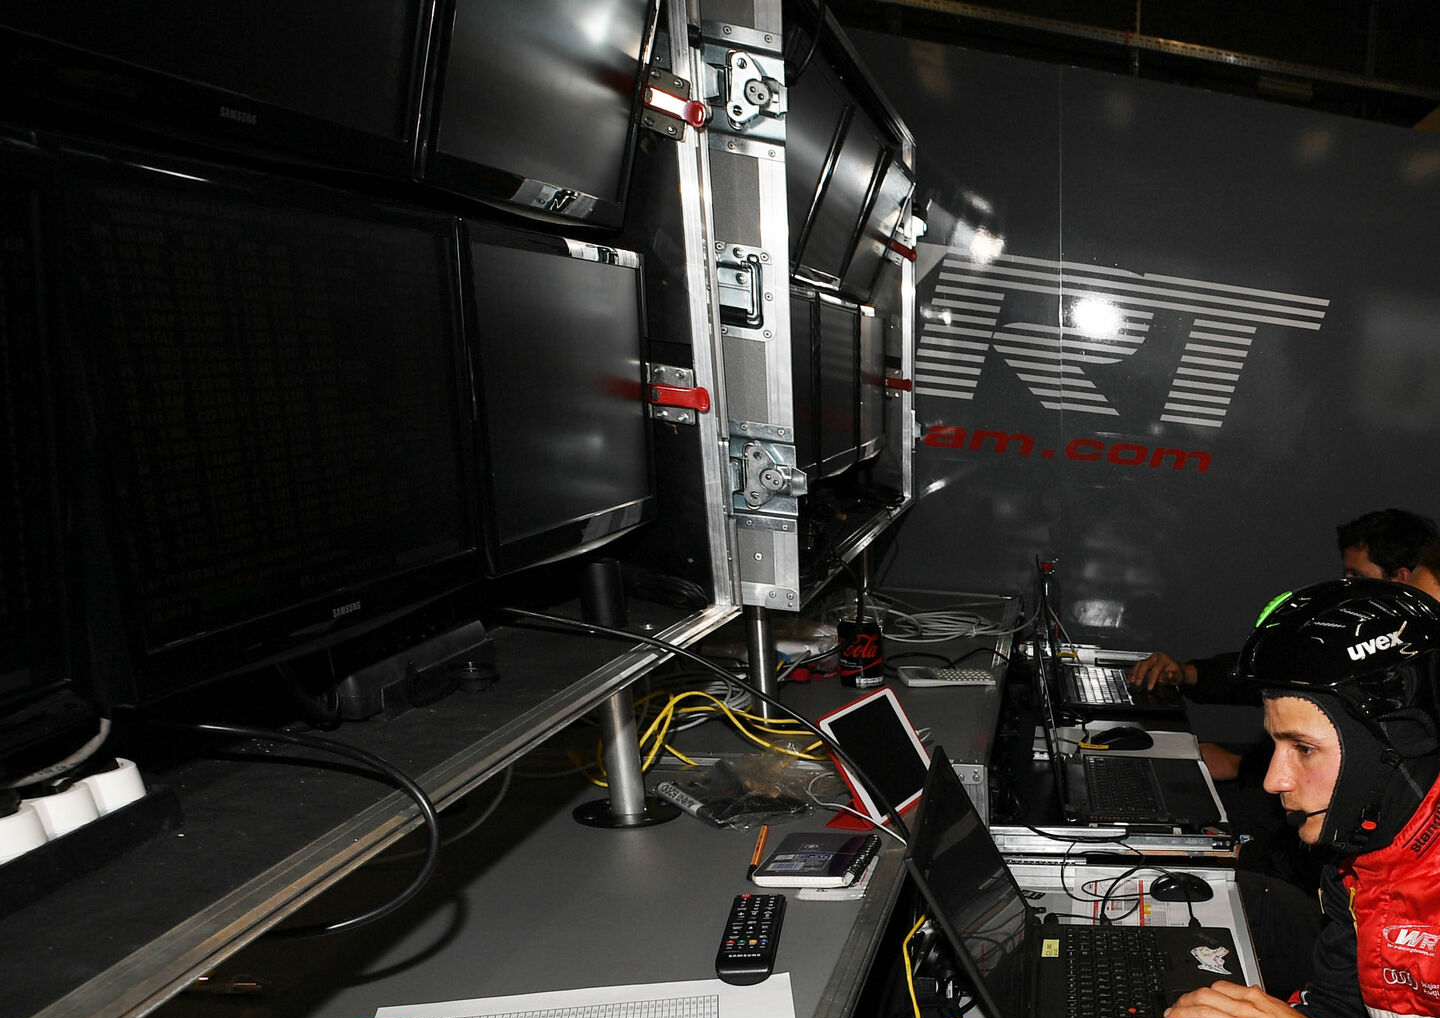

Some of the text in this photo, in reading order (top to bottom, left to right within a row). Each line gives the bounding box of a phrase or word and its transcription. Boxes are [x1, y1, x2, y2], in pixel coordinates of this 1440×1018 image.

[915, 244, 1331, 428] RT
[1347, 630, 1404, 661] uvex
[1395, 928, 1440, 951] WR
